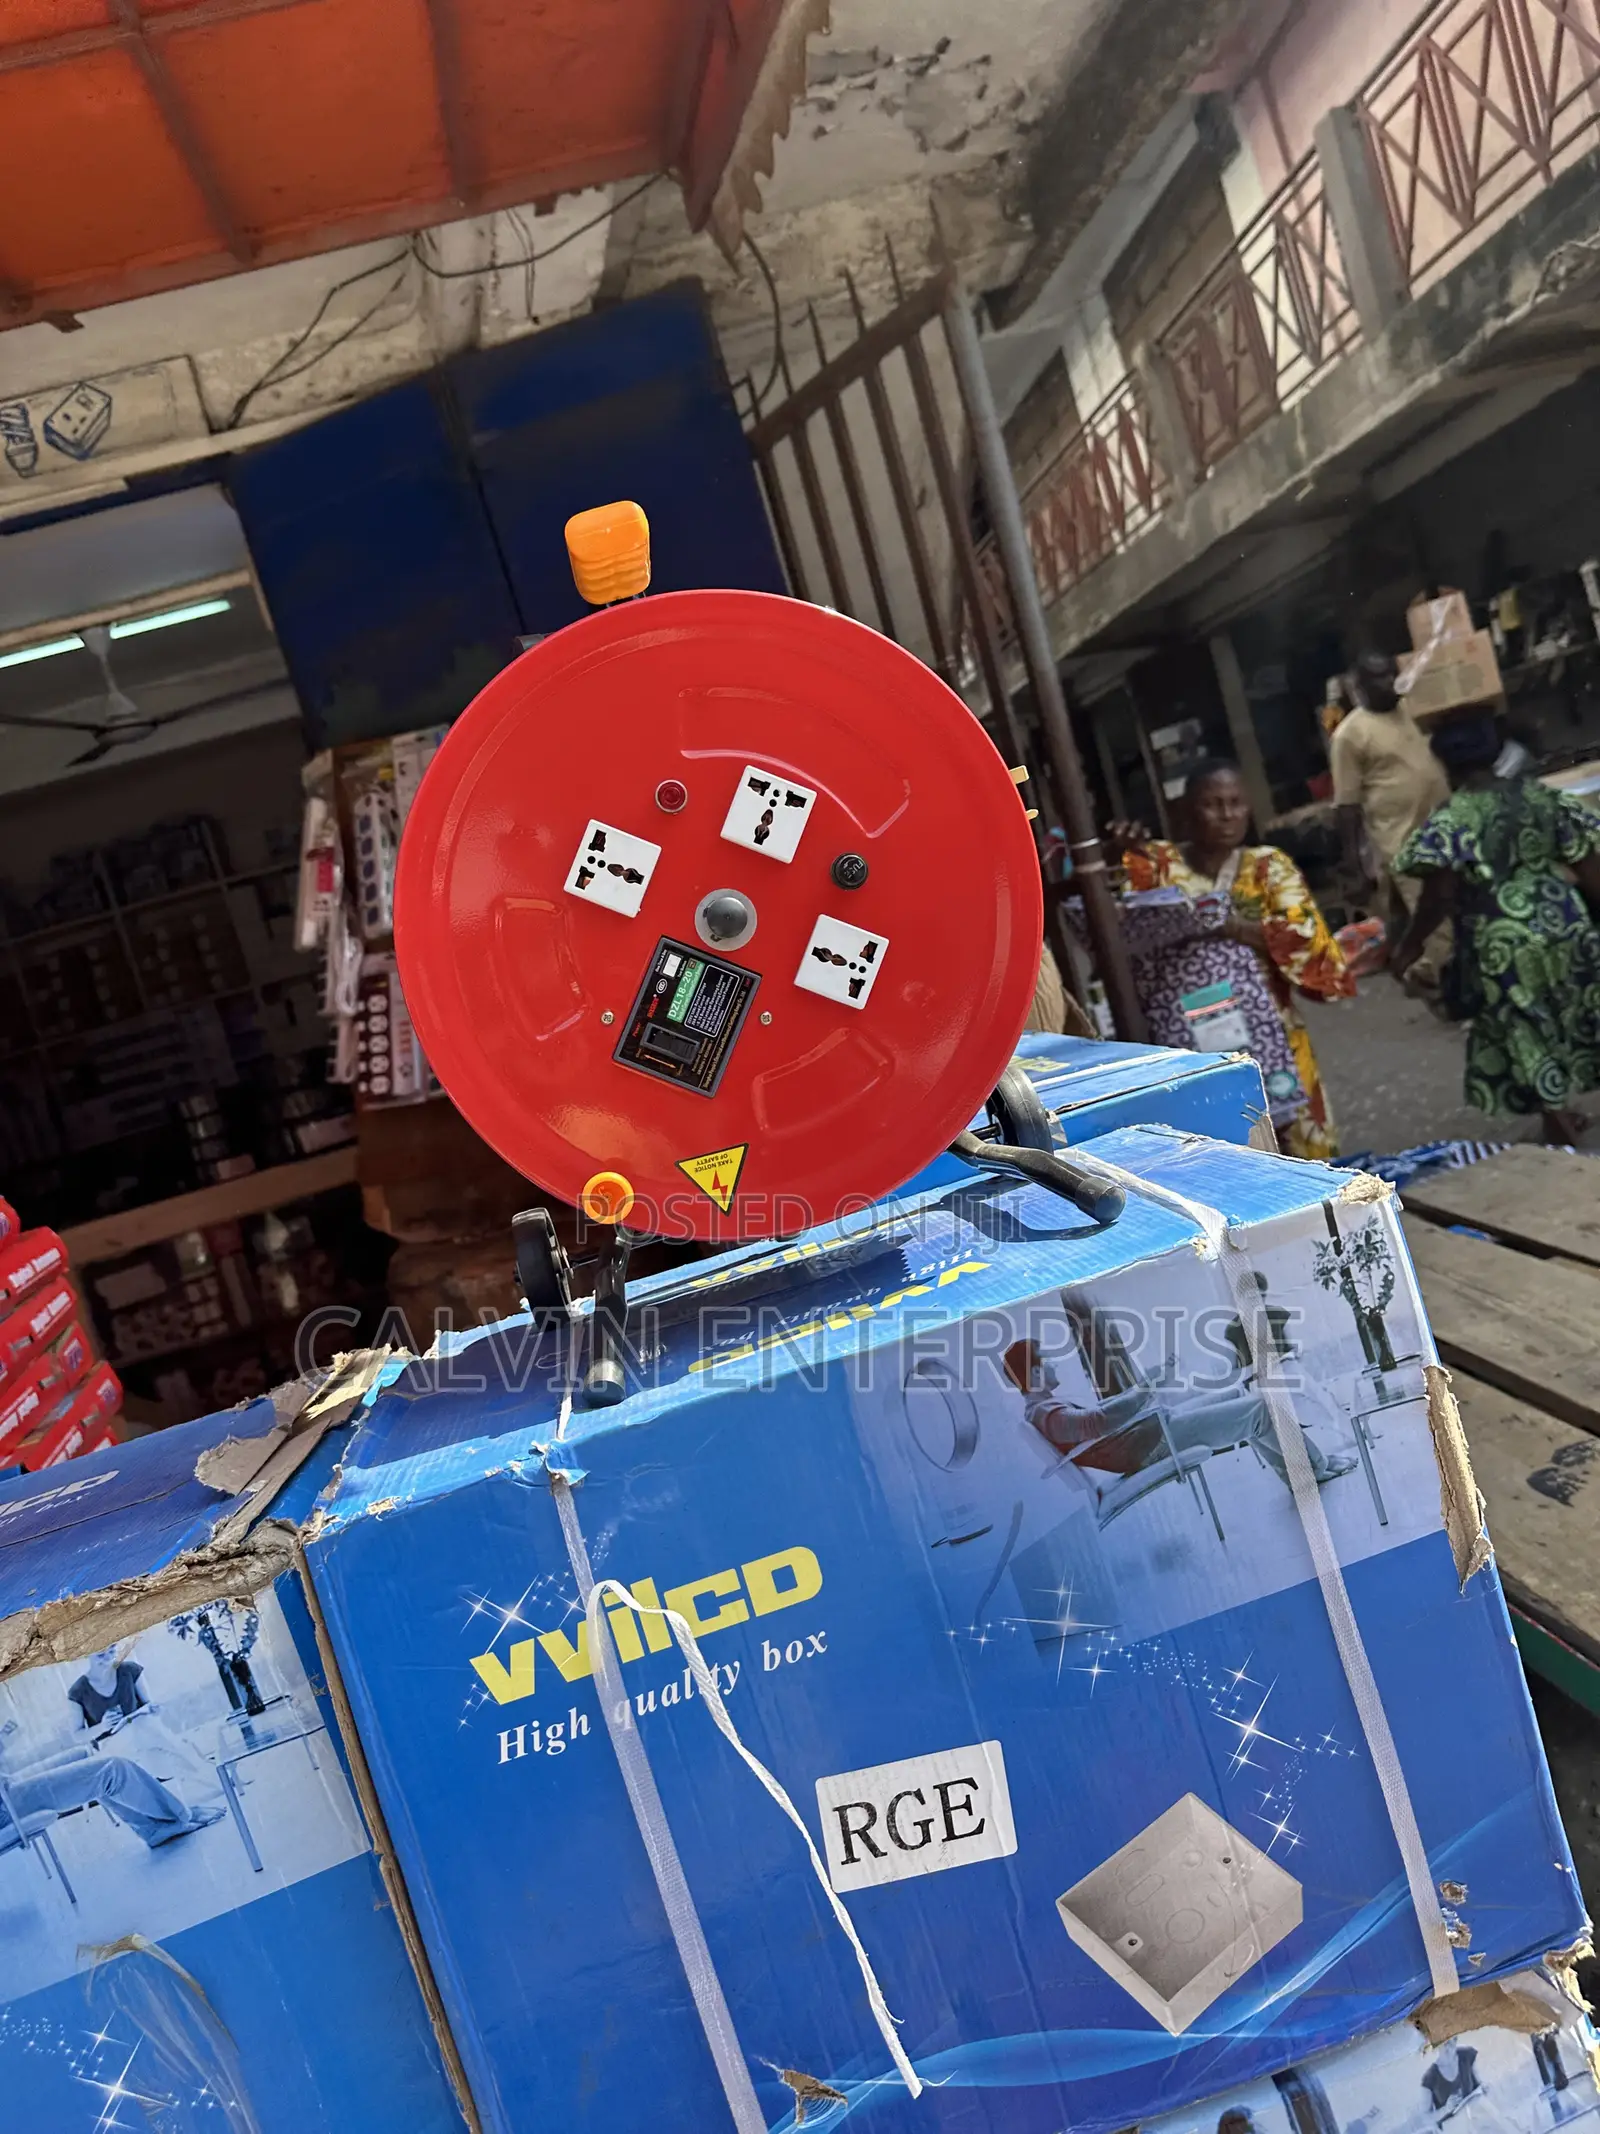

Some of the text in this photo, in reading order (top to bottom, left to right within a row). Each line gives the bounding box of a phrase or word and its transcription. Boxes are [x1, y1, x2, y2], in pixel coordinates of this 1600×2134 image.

[694, 1158, 733, 1173] TAKE NOTICE
[697, 1155, 719, 1166] SAFETY
[497, 1630, 828, 1765] High qualty box
[832, 1776, 986, 1866] RGE
